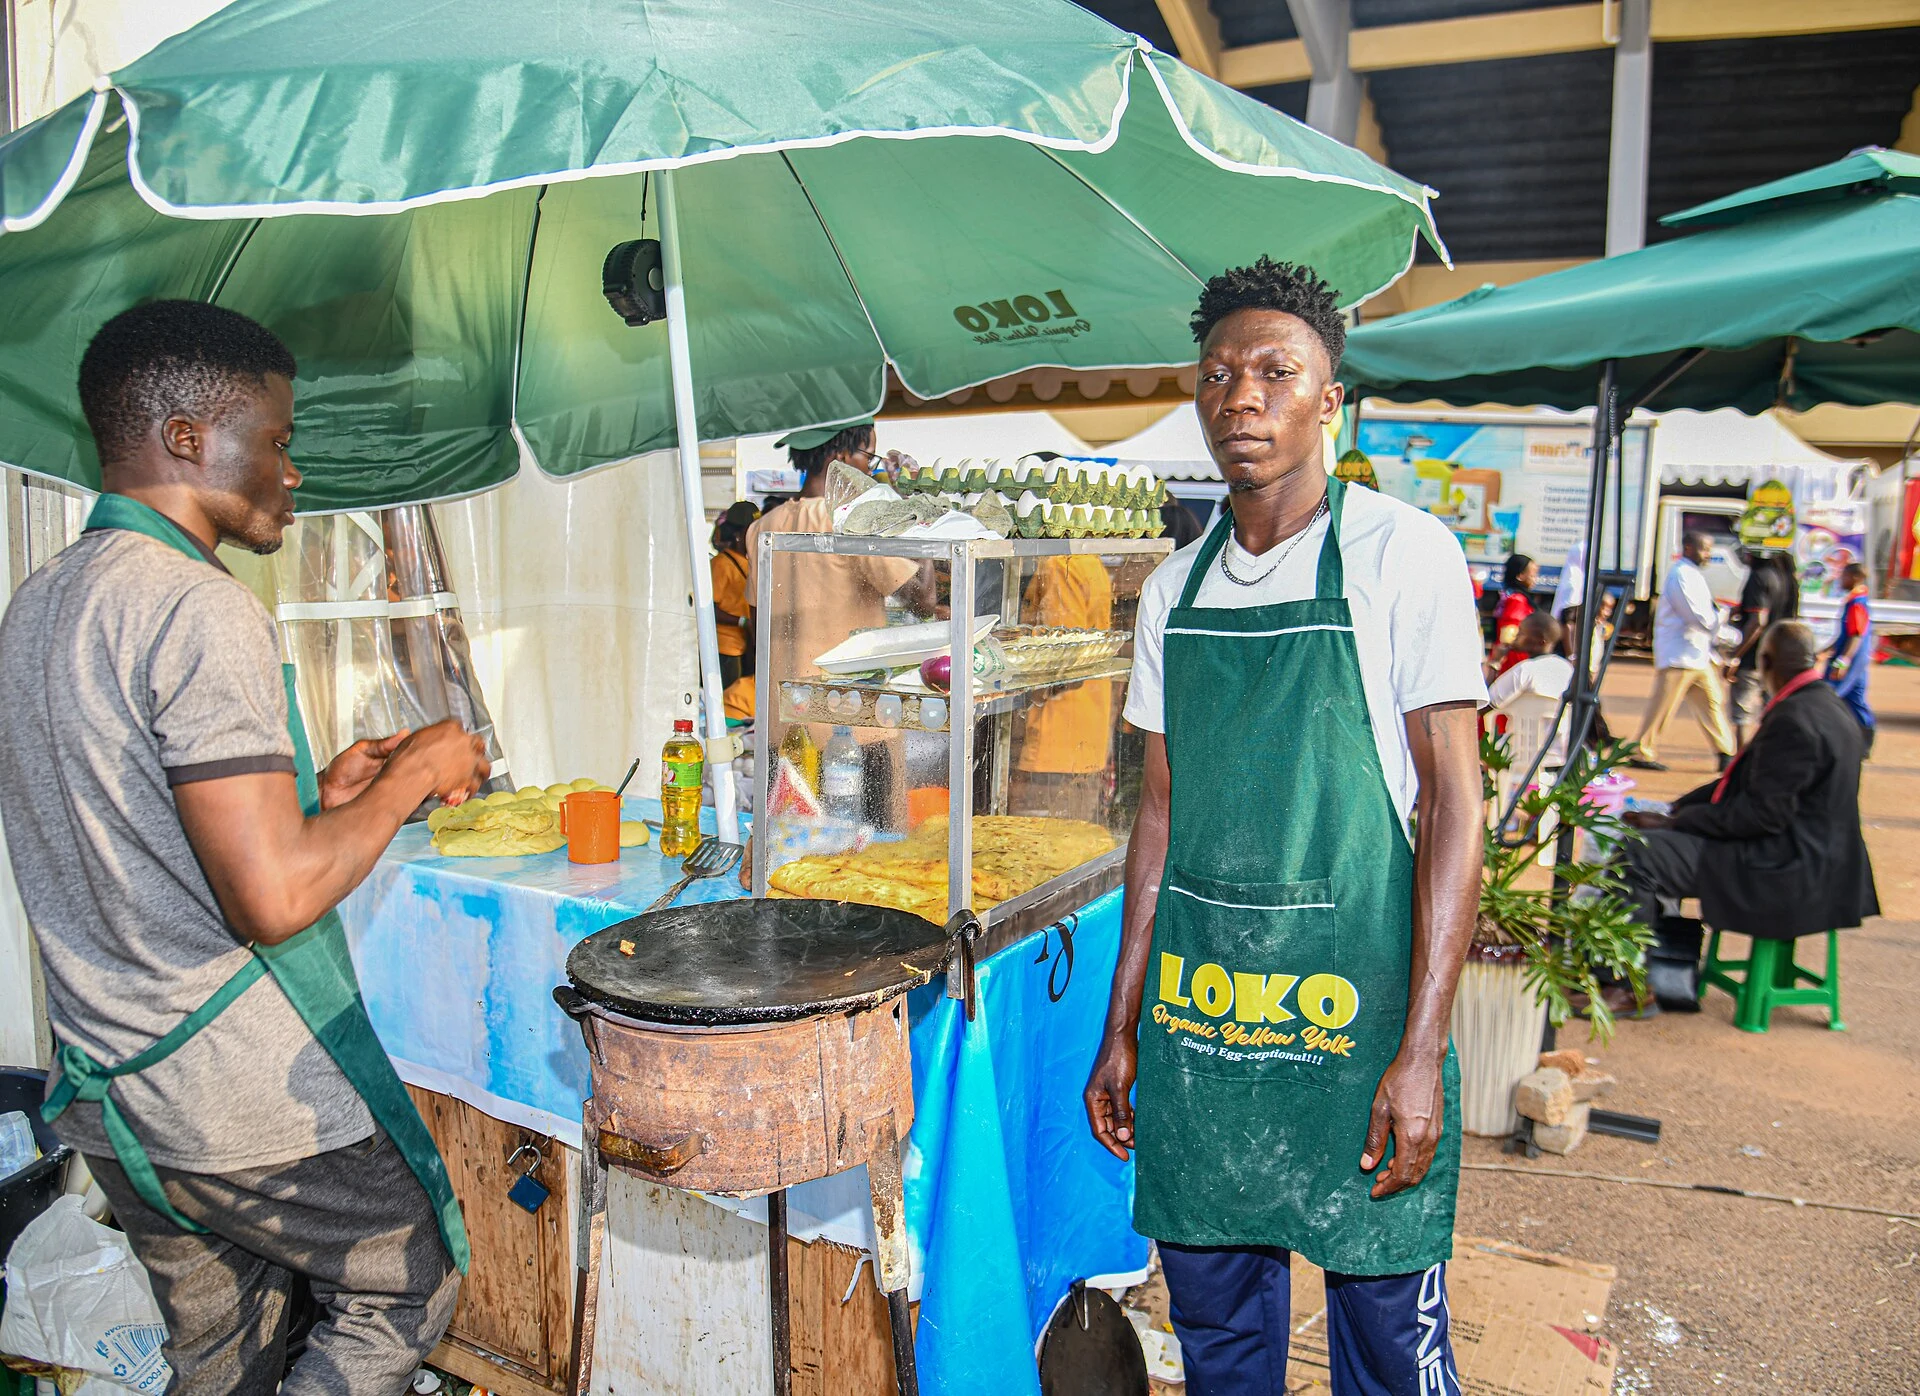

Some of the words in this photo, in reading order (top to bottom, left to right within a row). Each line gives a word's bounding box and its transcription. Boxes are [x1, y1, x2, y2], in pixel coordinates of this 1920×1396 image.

[1158, 951, 1360, 1030] LOKO
[1152, 1003, 1218, 1039] Organic
[1219, 1021, 1296, 1048] Yellow
[1300, 1025, 1356, 1057] Yolk
[1180, 1036, 1217, 1056] Simply
[1217, 1049, 1324, 1066] Egg-ceptional!!!
[138, 1367, 162, 1389] FOOD
